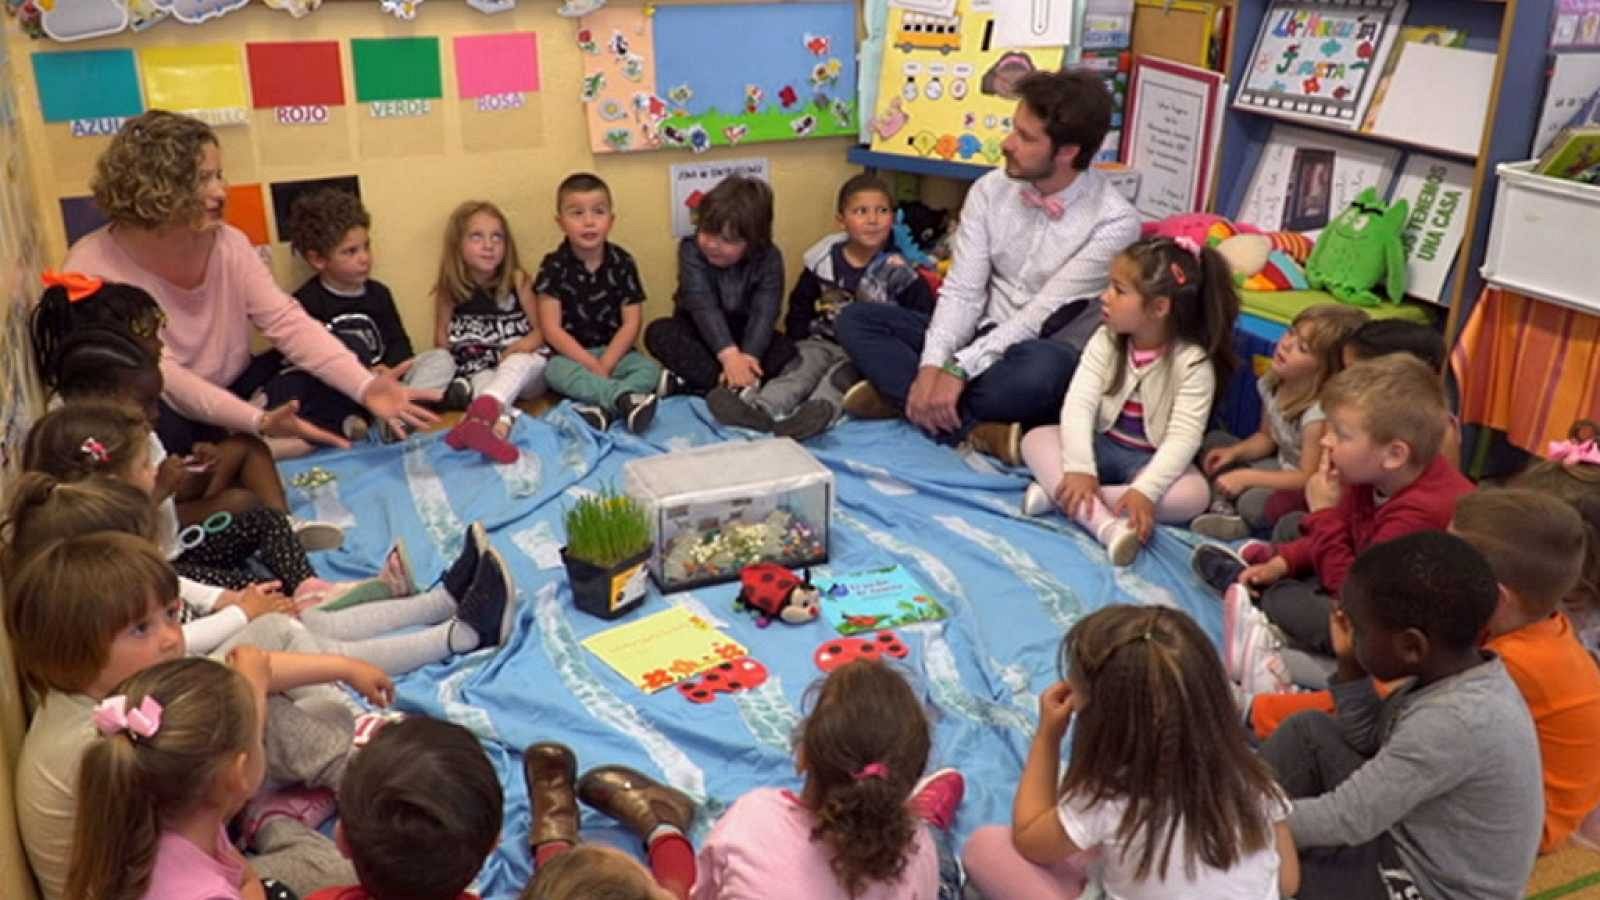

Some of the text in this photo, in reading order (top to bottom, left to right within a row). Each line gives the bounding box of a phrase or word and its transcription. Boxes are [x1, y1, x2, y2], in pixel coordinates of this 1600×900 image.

[371, 99, 429, 118] VERDE
[478, 92, 523, 111] ROSA
[276, 105, 326, 123] ROJO
[72, 117, 125, 136] AZUL
[1415, 190, 1462, 262] UNA CASA
